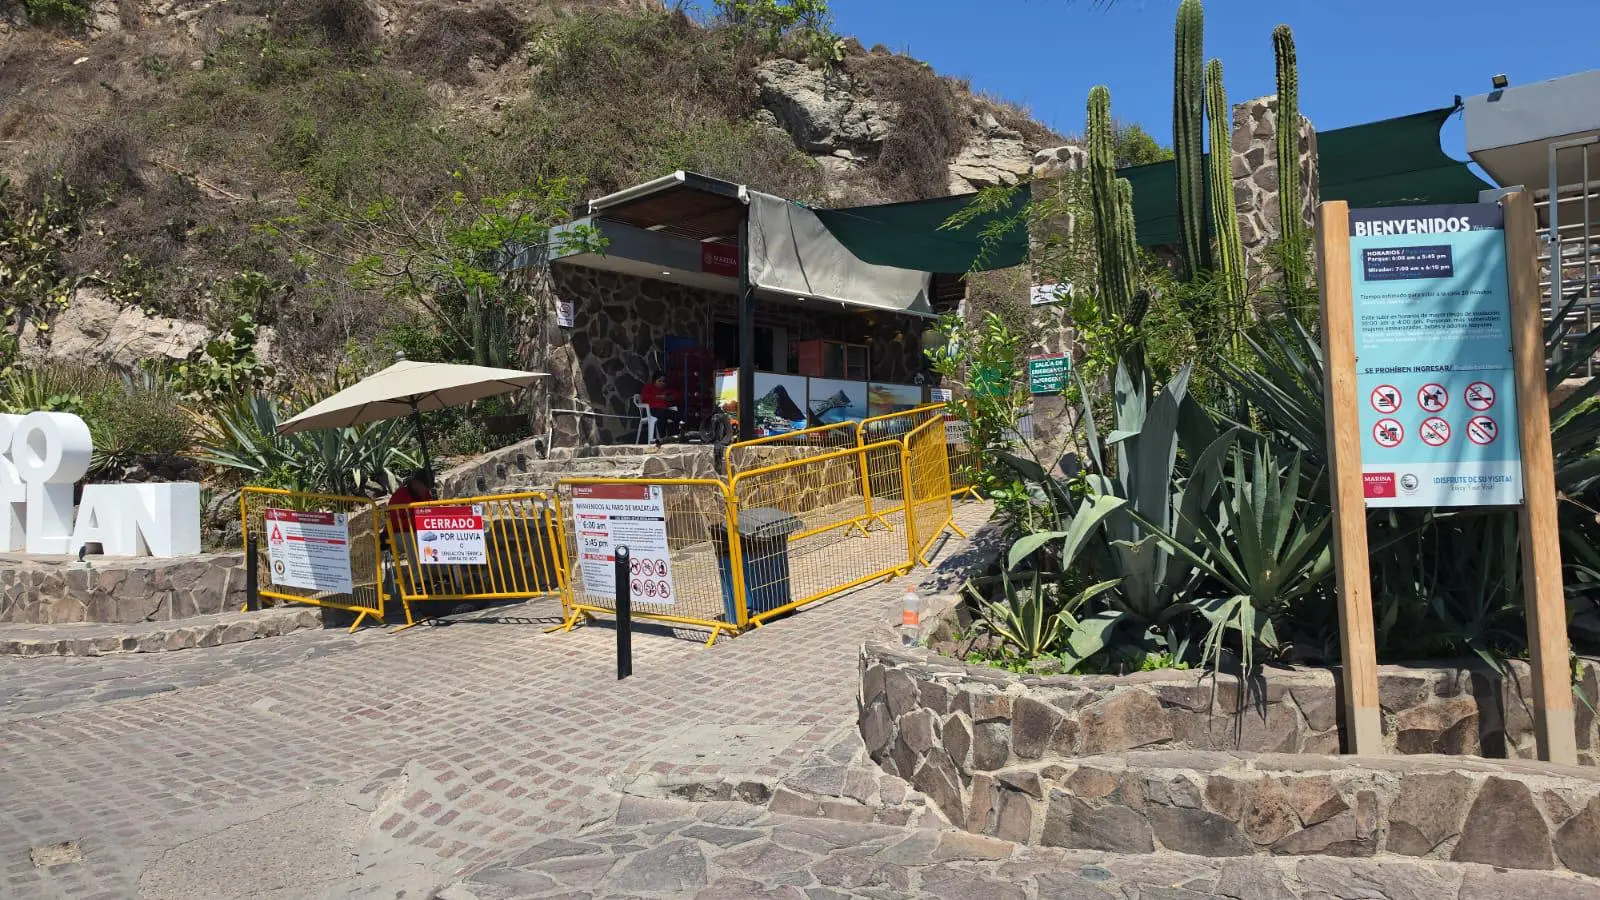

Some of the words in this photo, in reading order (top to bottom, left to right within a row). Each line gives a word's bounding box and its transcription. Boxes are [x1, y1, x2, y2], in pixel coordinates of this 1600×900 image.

[1355, 216, 1470, 236] BIENVENIDOS
[1478, 475, 1487, 483] SU
[423, 518, 475, 529] CERRADO
[440, 532, 455, 541] POR
[456, 532, 481, 541] LLUVIA
